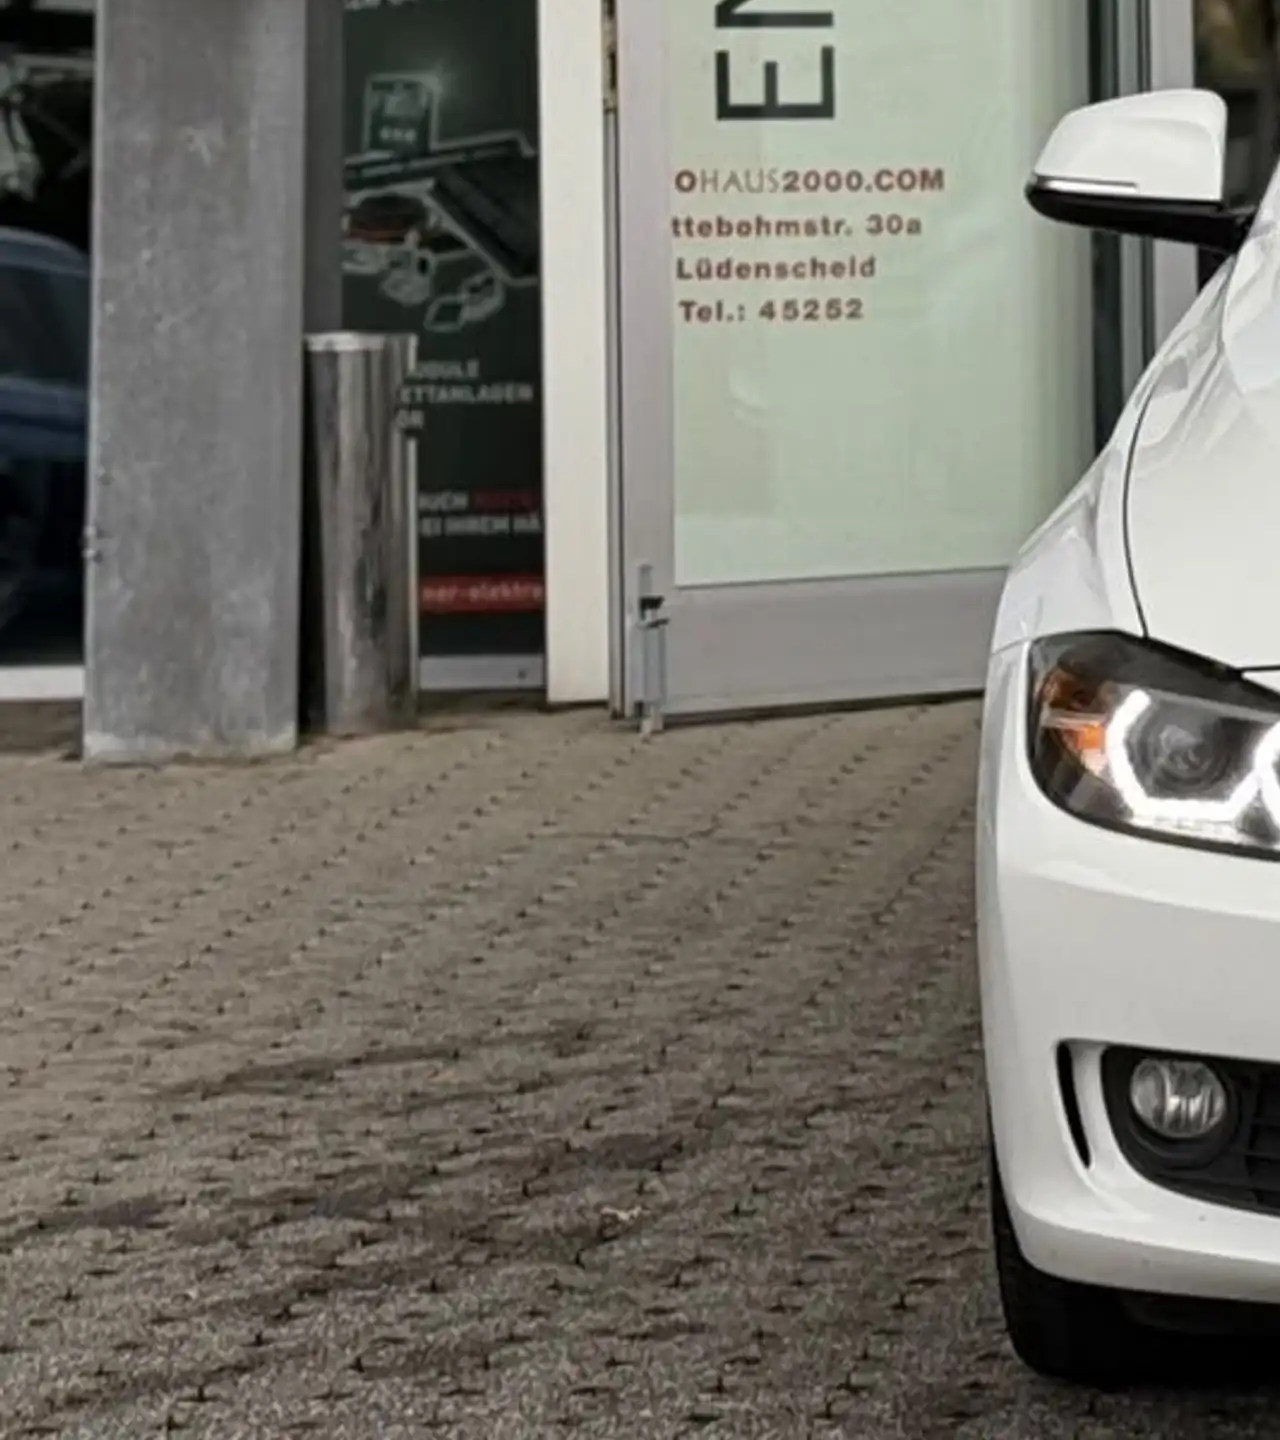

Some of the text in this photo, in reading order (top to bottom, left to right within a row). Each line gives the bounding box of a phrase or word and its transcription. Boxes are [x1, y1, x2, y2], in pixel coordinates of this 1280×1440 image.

[866, 213, 922, 237] 30a
[676, 255, 877, 281] Lüdenscheid
[758, 297, 864, 321] 45252
